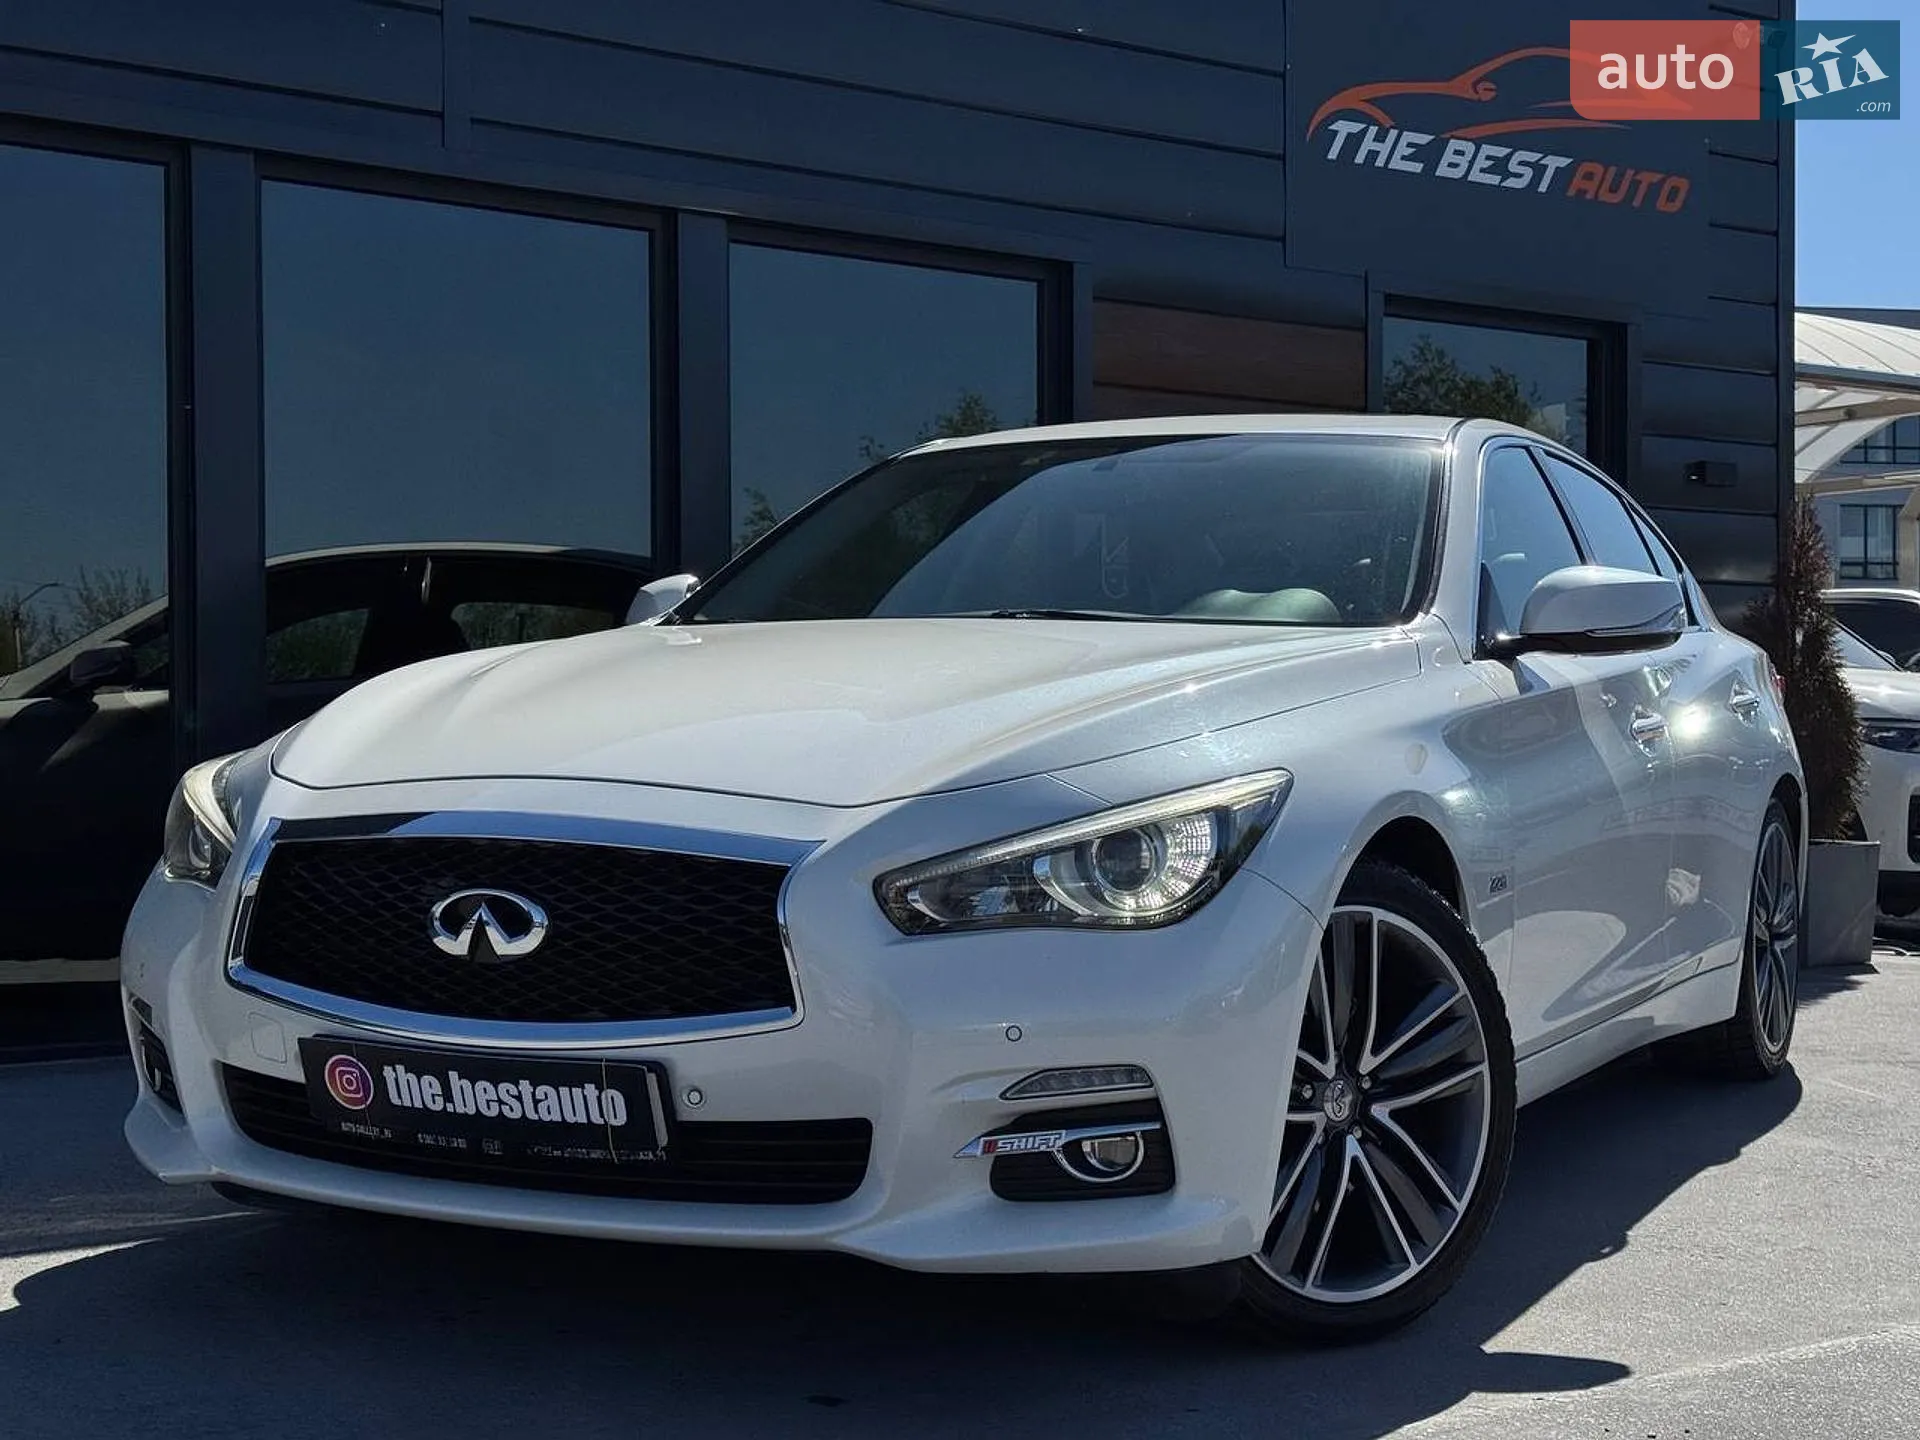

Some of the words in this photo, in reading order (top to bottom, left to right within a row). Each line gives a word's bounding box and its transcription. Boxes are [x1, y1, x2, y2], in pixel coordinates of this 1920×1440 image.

[1326, 119, 1436, 173] THE
[1435, 138, 1573, 193] BEST
[1566, 161, 1689, 213] AUTO
[382, 1064, 627, 1127] the.bestauto
